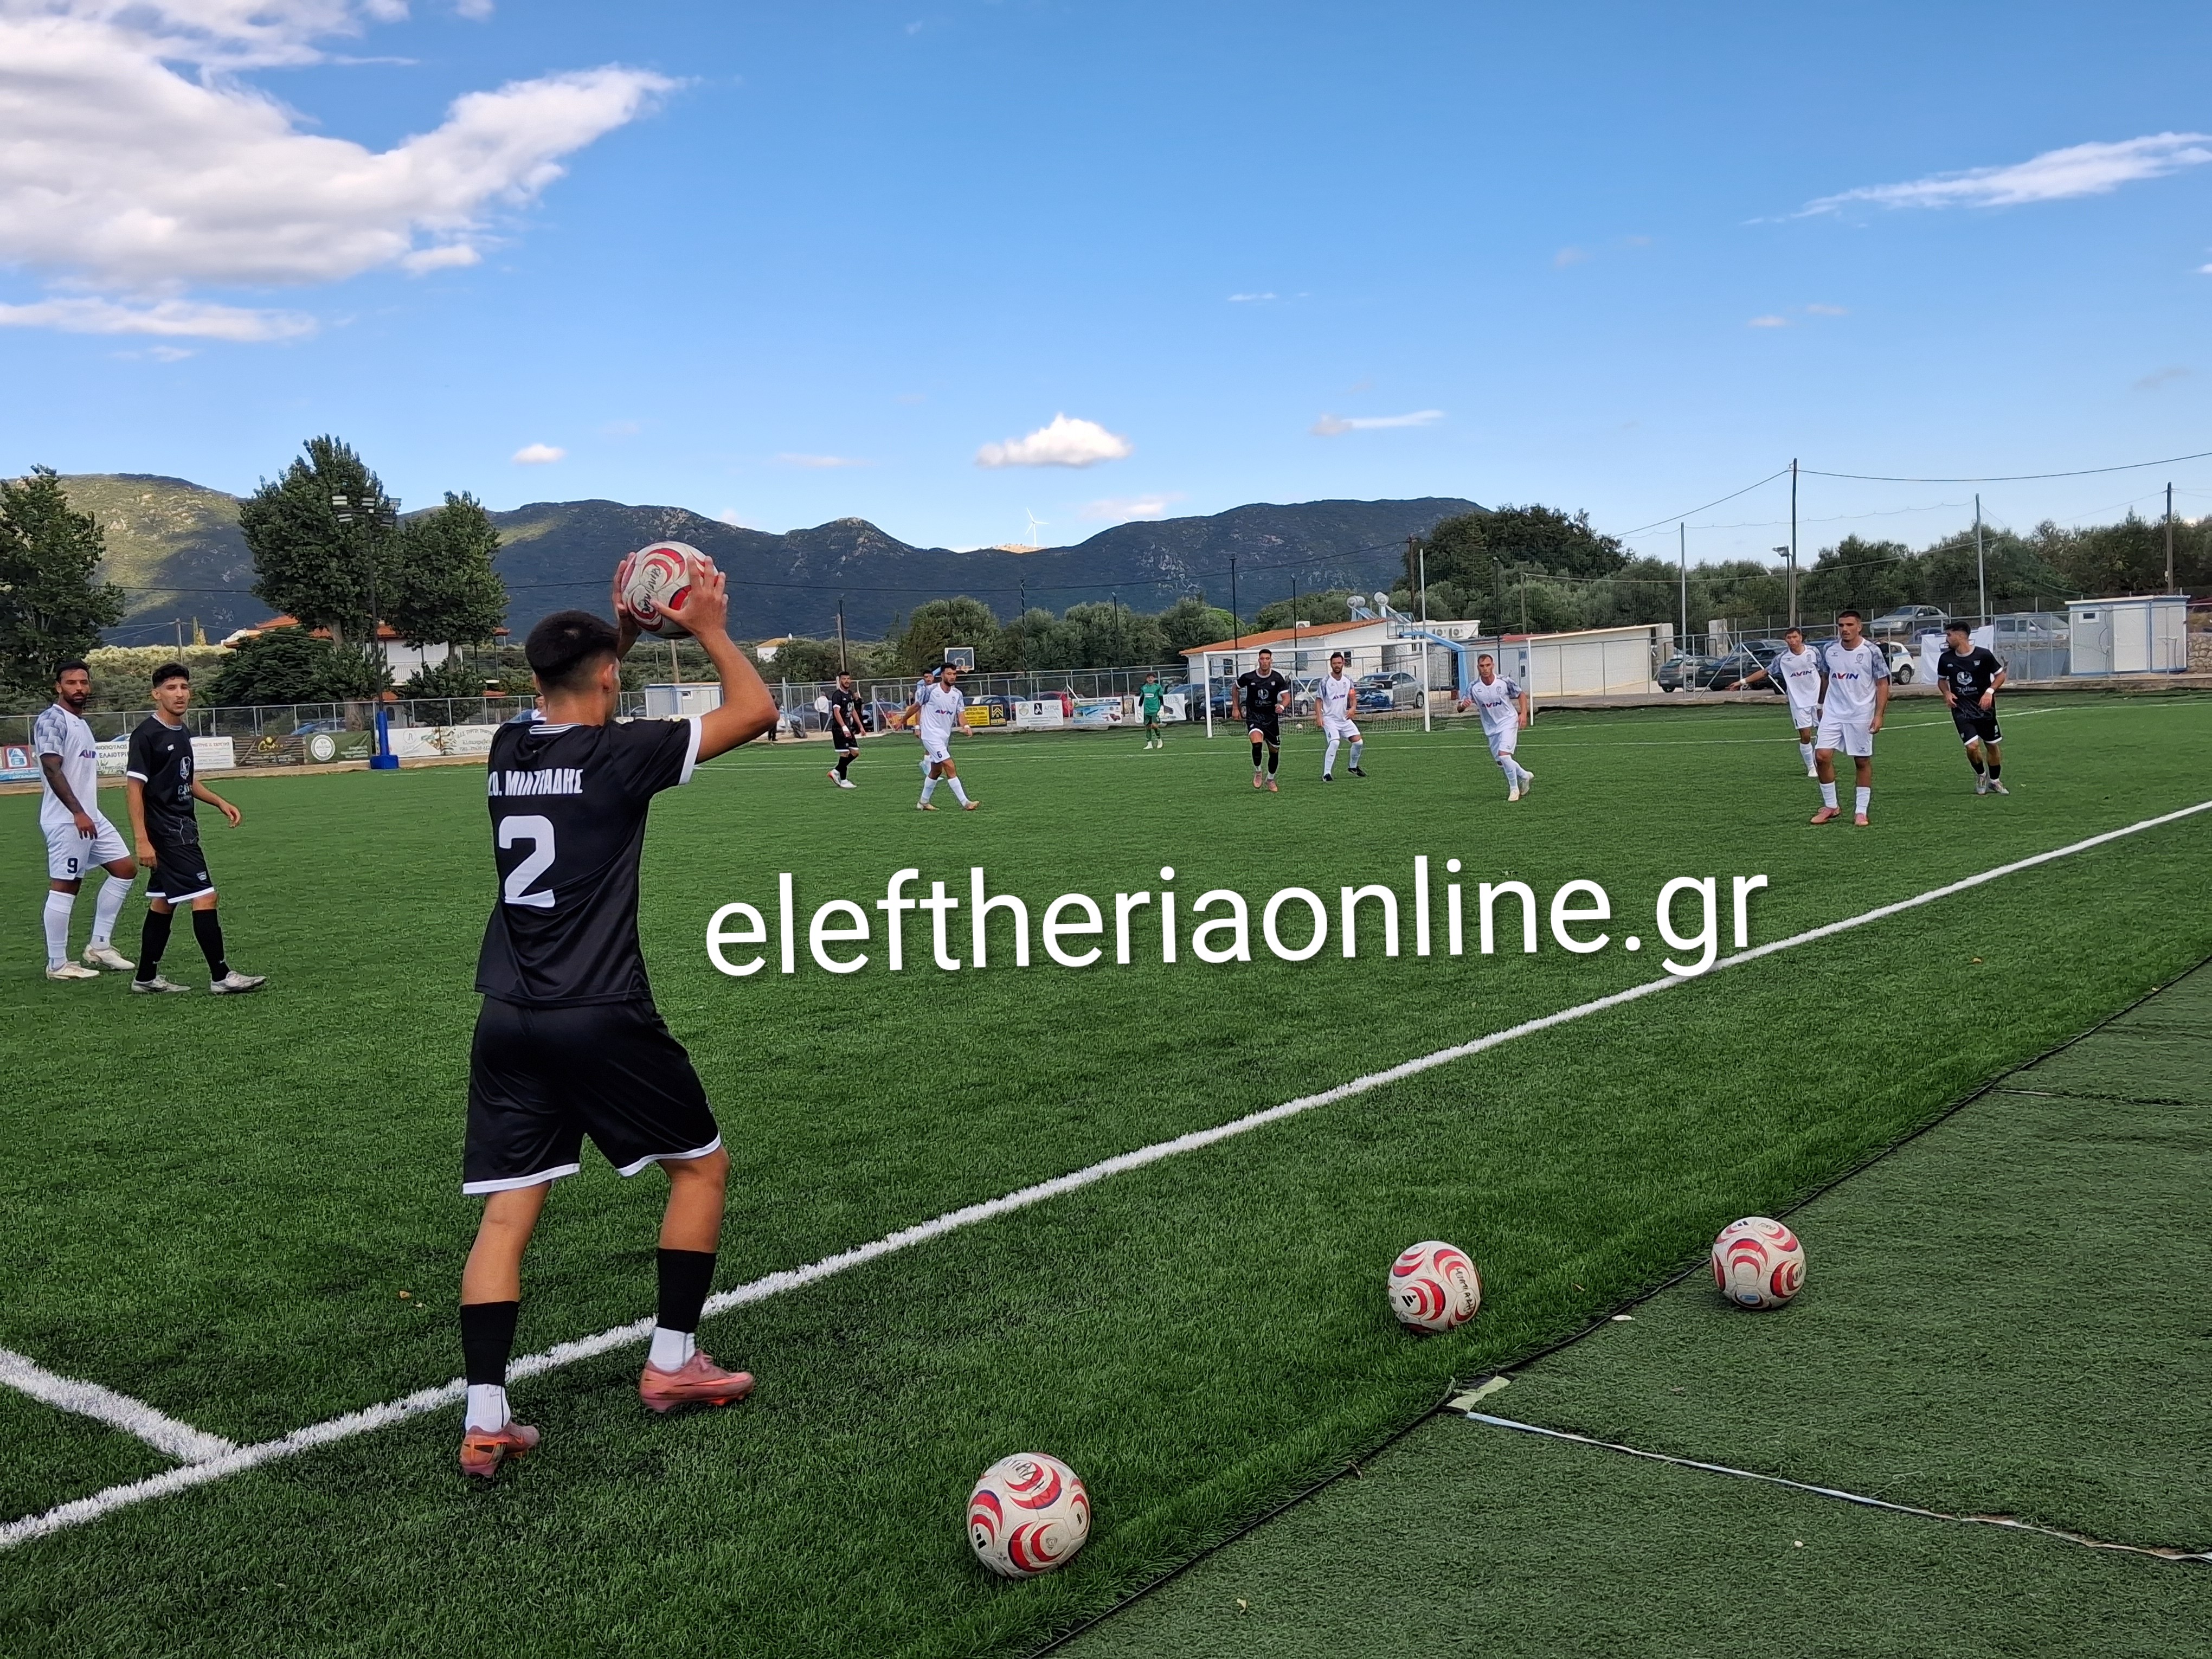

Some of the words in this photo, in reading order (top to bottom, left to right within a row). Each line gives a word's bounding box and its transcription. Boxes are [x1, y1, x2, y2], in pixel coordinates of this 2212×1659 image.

[1790, 669, 1812, 678] AVIN
[936, 750, 942, 758] 6
[505, 768, 583, 796] ΜΙΛΤΙΑΔΗΣ
[67, 857, 78, 874] 9
[498, 814, 556, 908] 2
